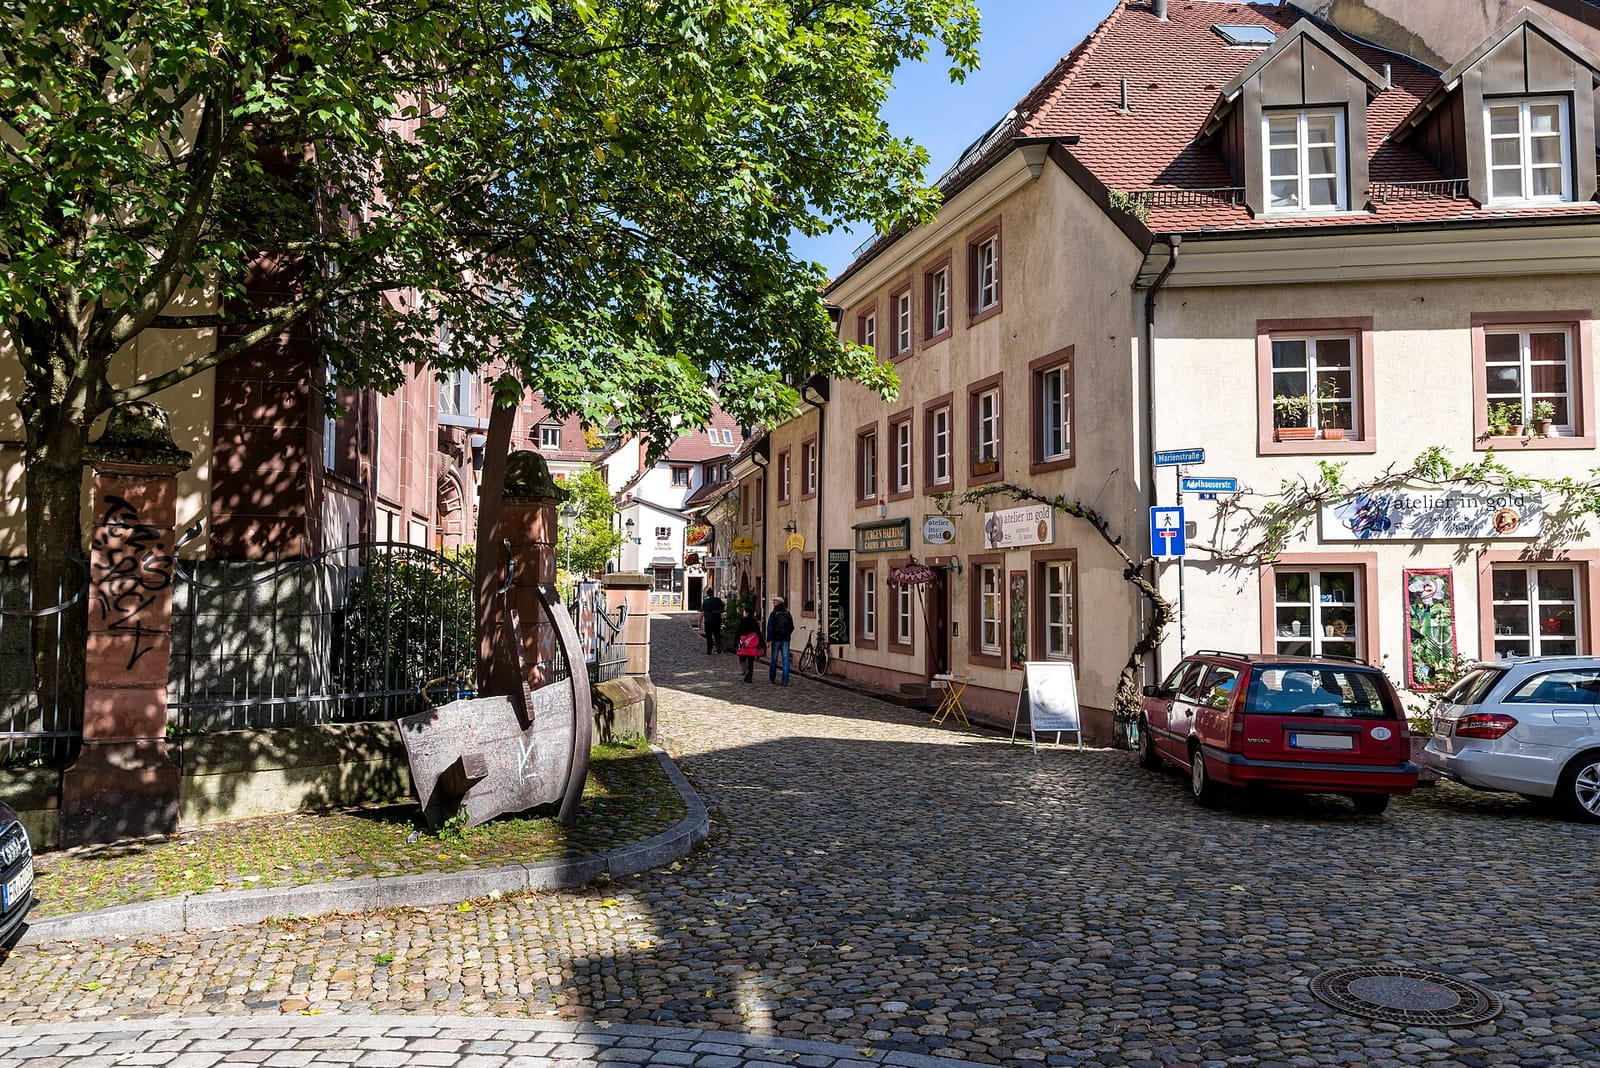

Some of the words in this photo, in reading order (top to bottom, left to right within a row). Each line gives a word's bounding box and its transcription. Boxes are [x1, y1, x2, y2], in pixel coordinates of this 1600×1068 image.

[1158, 452, 1200, 462] Marienstraße
[1186, 480, 1232, 489] Adelhauserstr.
[1394, 495, 1453, 510] atelier
[1460, 494, 1478, 508] in
[1486, 493, 1525, 511] gold
[1004, 511, 1025, 524] atelier
[1026, 510, 1033, 521] in
[1035, 506, 1050, 523] gold
[928, 532, 942, 540] gold
[829, 562, 840, 641] ANTIKEN
